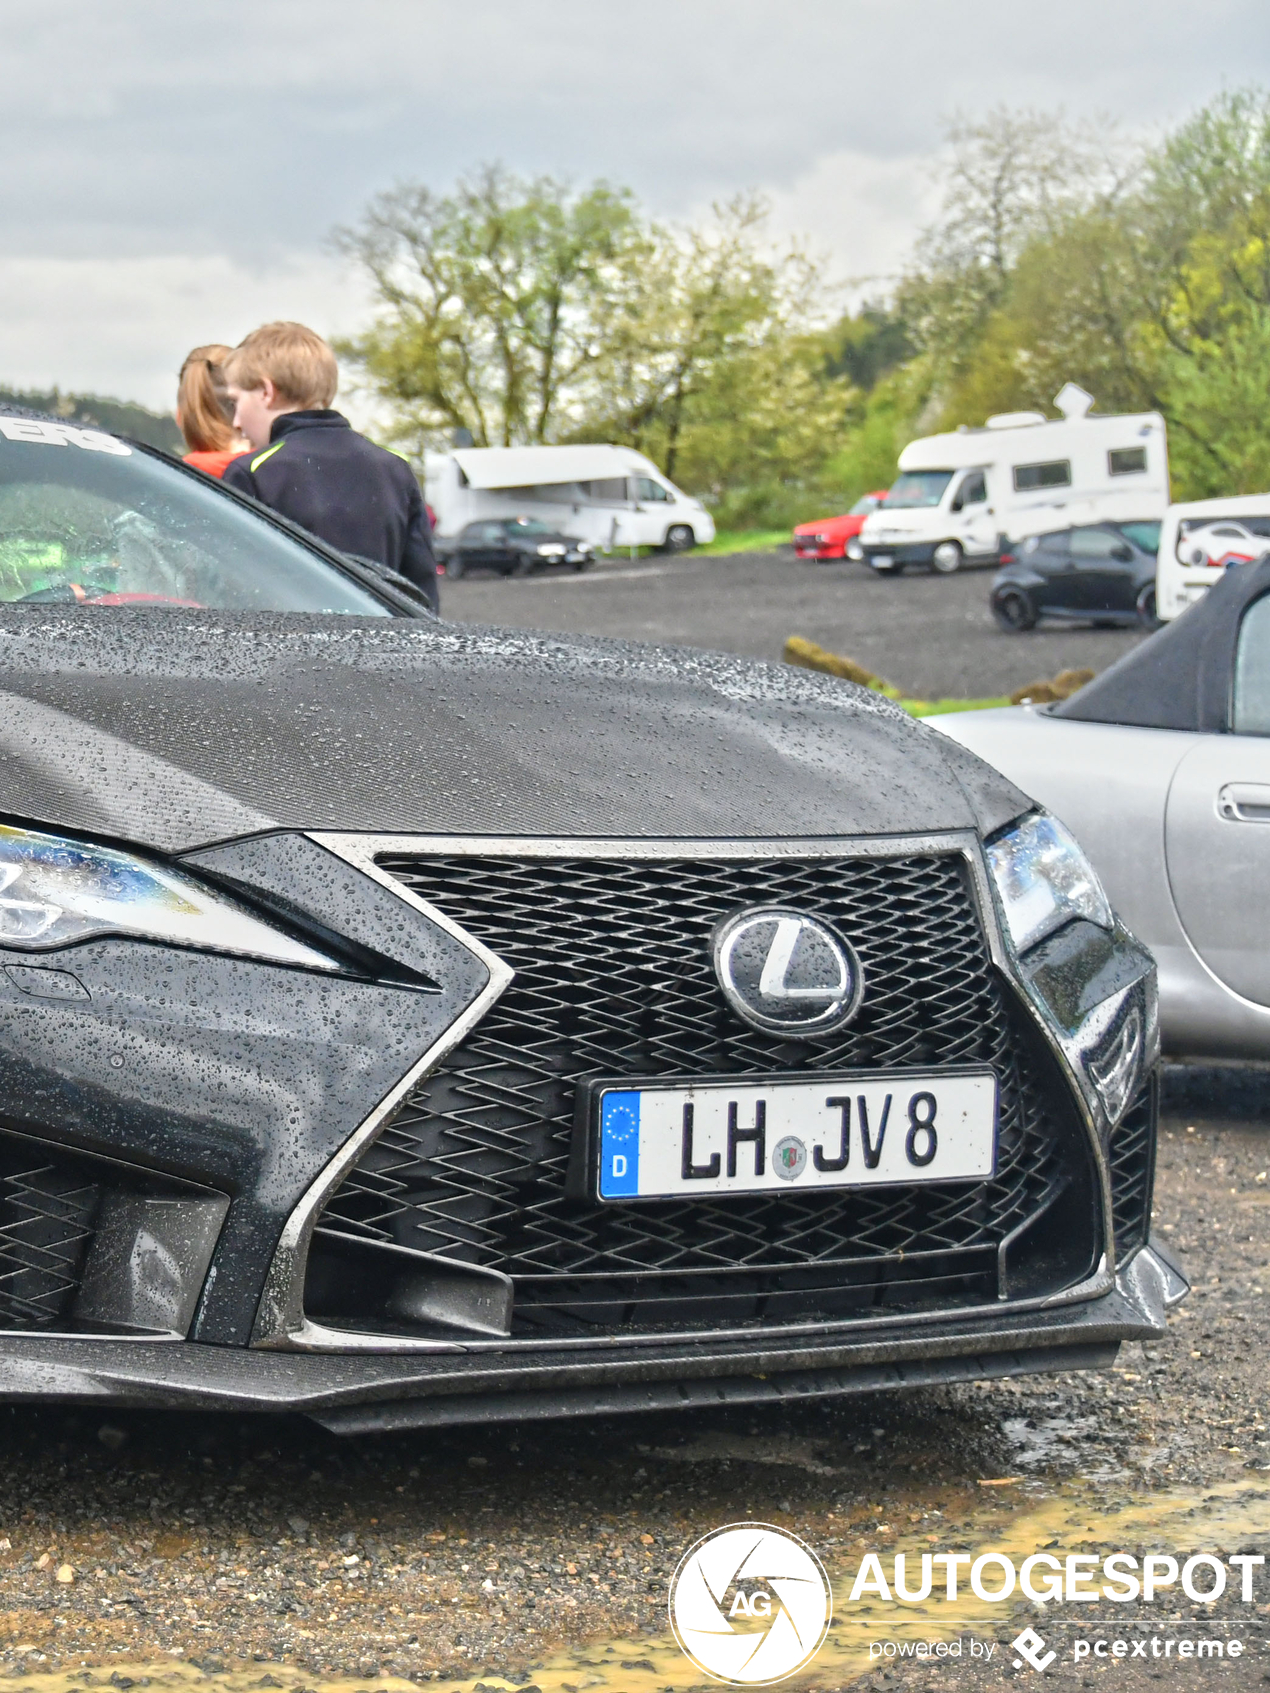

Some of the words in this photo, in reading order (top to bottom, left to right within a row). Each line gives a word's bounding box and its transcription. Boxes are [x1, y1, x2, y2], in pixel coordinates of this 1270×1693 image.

[681, 1099, 767, 1180] LH
[813, 1093, 894, 1172] JV
[905, 1091, 938, 1168] 8
[612, 1154, 628, 1178] D
